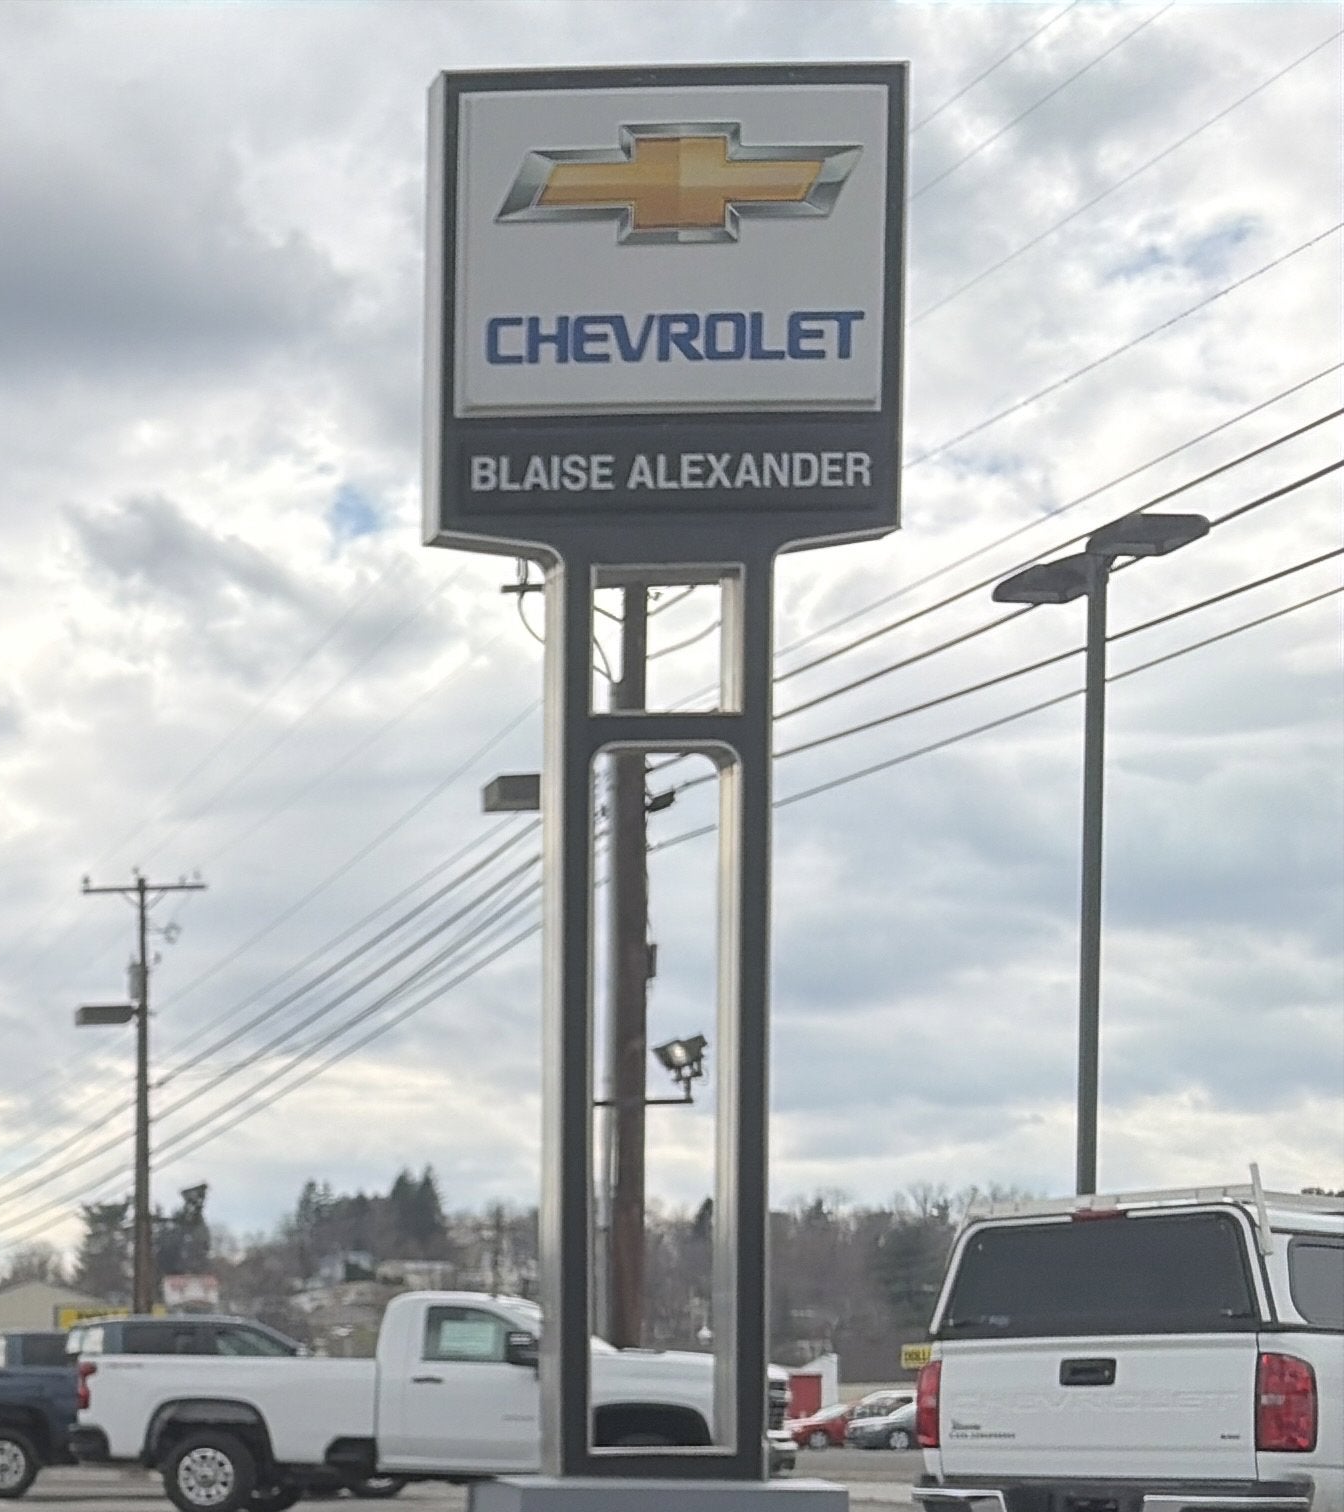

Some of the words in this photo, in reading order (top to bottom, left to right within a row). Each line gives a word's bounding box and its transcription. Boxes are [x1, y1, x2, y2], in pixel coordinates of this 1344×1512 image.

[485, 310, 866, 364] CHEVROLET
[469, 453, 615, 492] BLAISE
[626, 451, 873, 490] ALEXANDER
